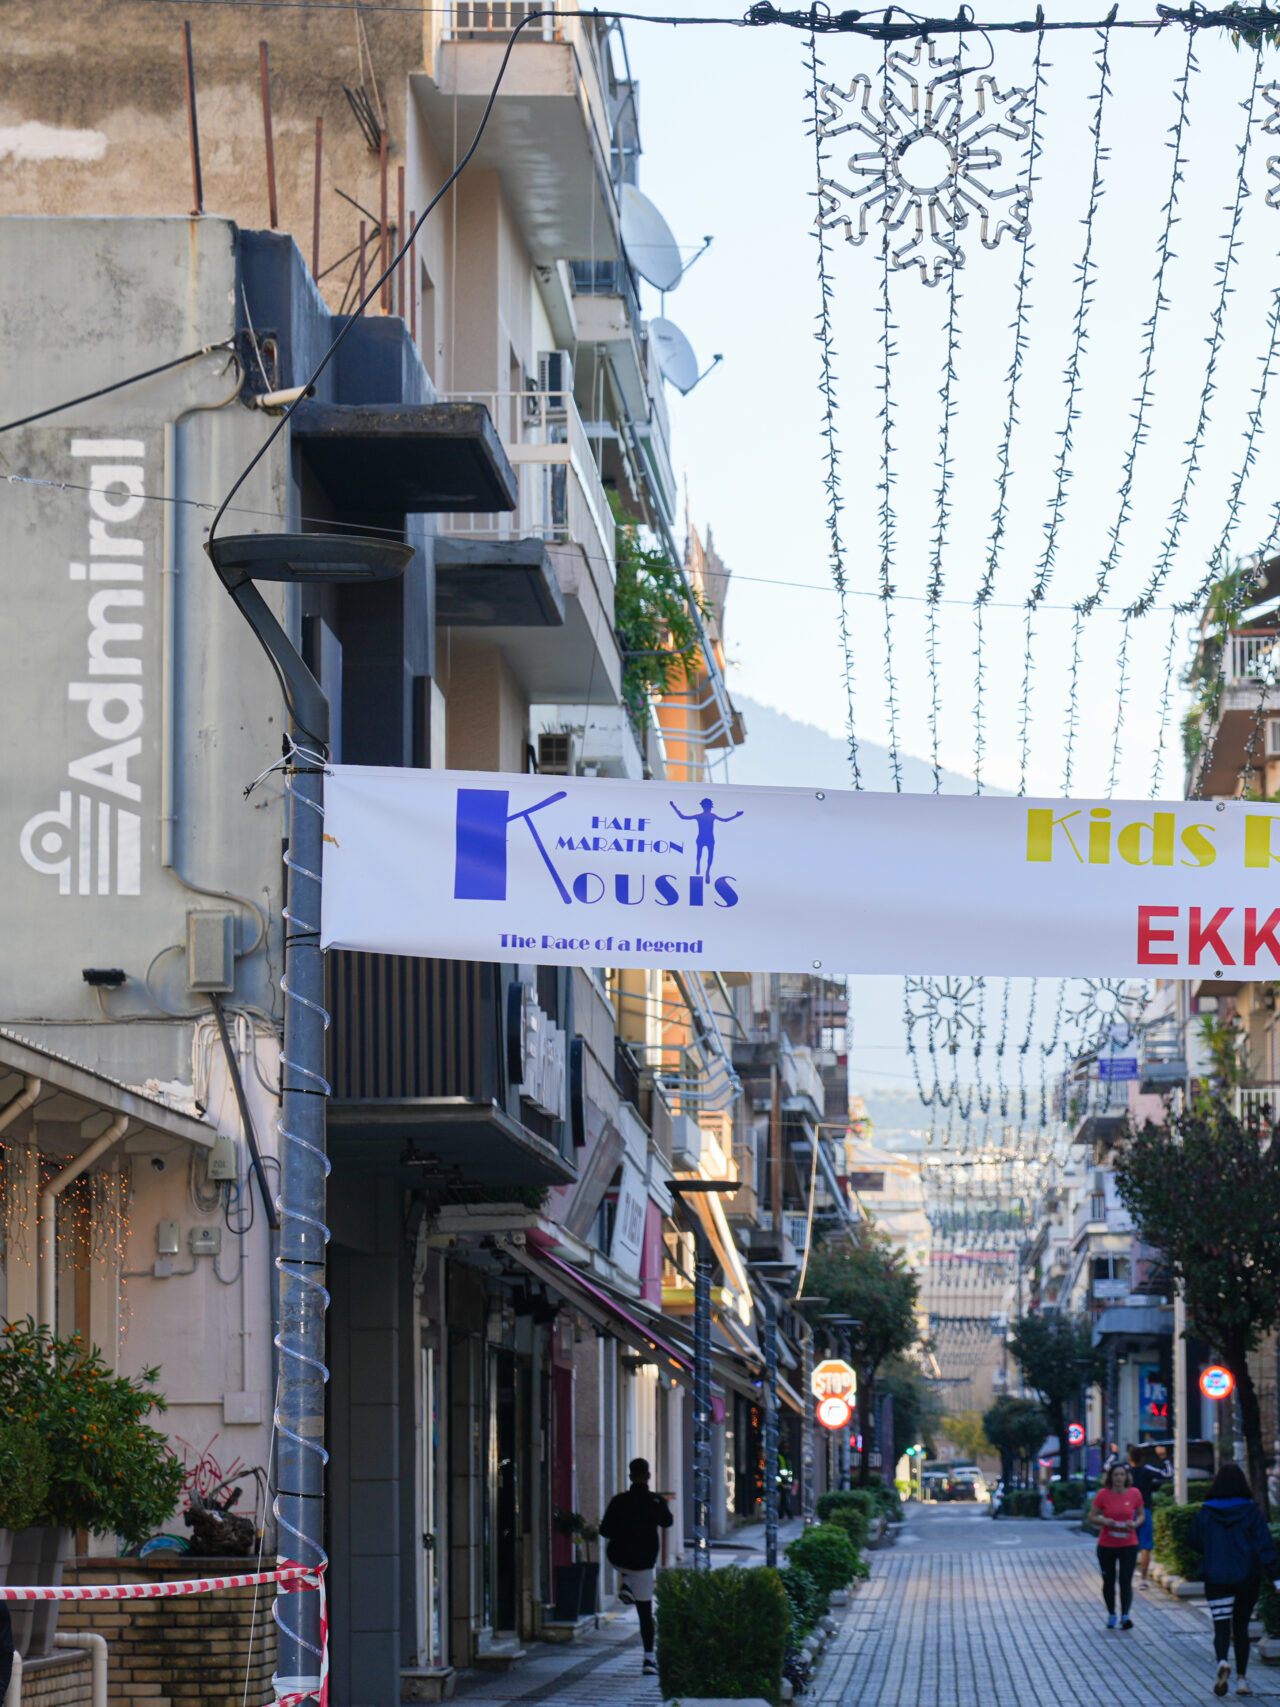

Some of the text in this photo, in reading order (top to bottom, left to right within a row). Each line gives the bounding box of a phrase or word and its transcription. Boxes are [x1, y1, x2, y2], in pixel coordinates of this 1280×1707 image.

[69, 439, 145, 802] Admiral
[592, 816, 651, 832] HALF
[555, 836, 684, 854] MARATHON
[1026, 807, 1217, 868] Kids
[498, 933, 703, 954] The Race of a legend
[816, 1372, 852, 1395] STOP
